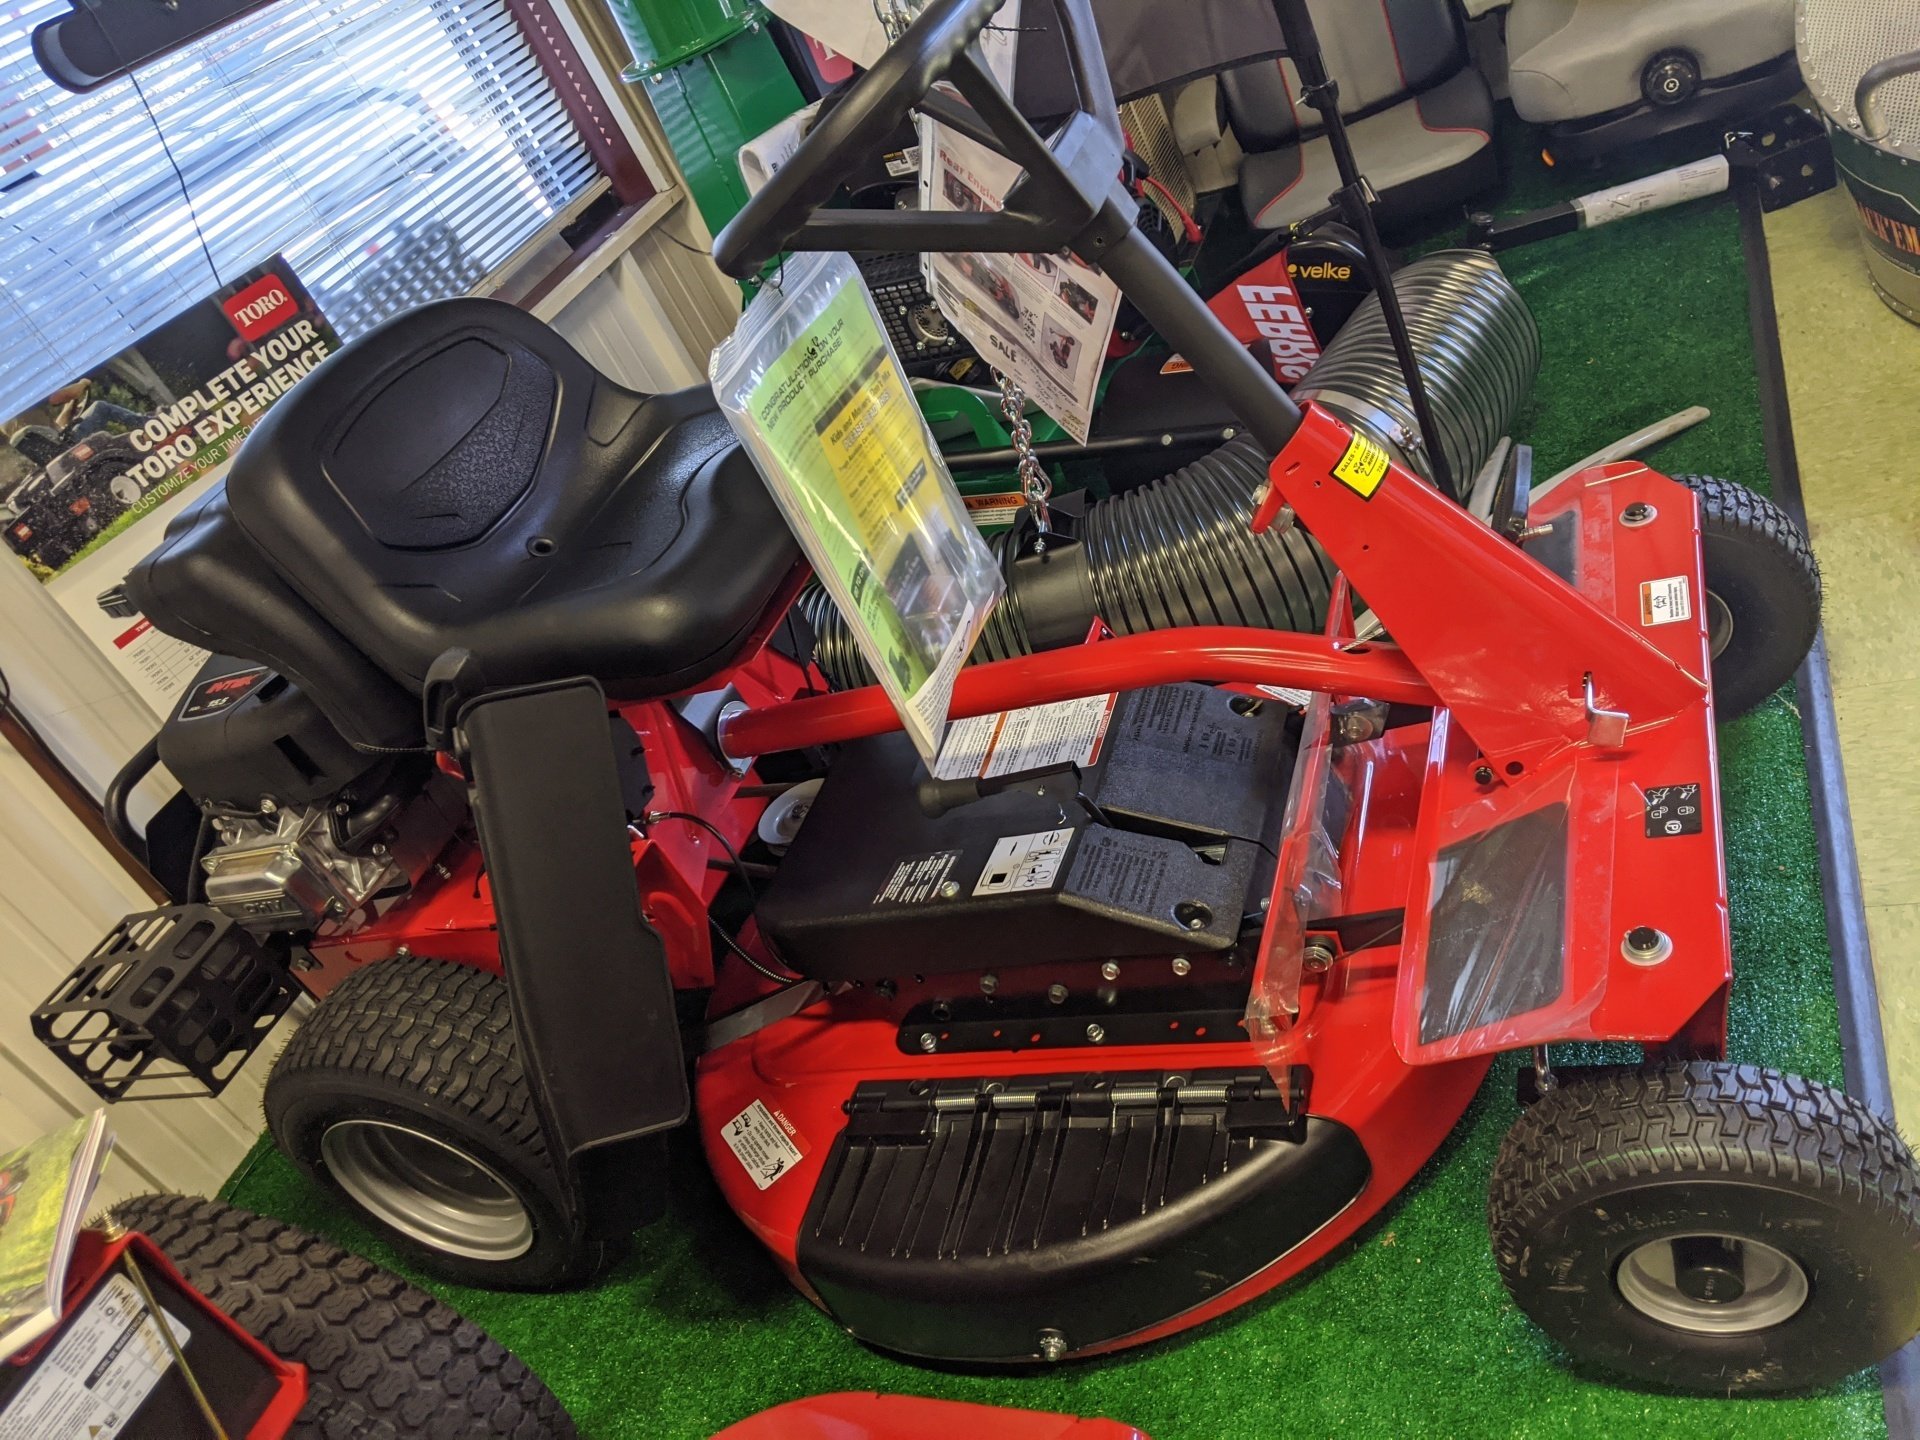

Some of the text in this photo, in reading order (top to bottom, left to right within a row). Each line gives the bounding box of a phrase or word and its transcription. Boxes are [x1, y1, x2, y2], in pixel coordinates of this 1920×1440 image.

[939, 149, 966, 178] Rear
[968, 170, 1003, 208] Engine
[1300, 262, 1351, 281] velke
[233, 289, 287, 327] TORO
[828, 317, 844, 339] YOUR
[989, 333, 1018, 364] SALE
[129, 319, 319, 452] COMPLETE YOUR
[776, 374, 809, 415] PRODUCT
[125, 341, 330, 488] TORO EXPERIENCE
[829, 426, 844, 446] Kids
[1339, 452, 1355, 473] SALES
[132, 468, 193, 515] CUSTOMIZE
[191, 448, 220, 477] YOUR
[975, 496, 1018, 508] WARNING
[1096, 714, 1109, 739] DANGER
[778, 1113, 797, 1137] DANGER
